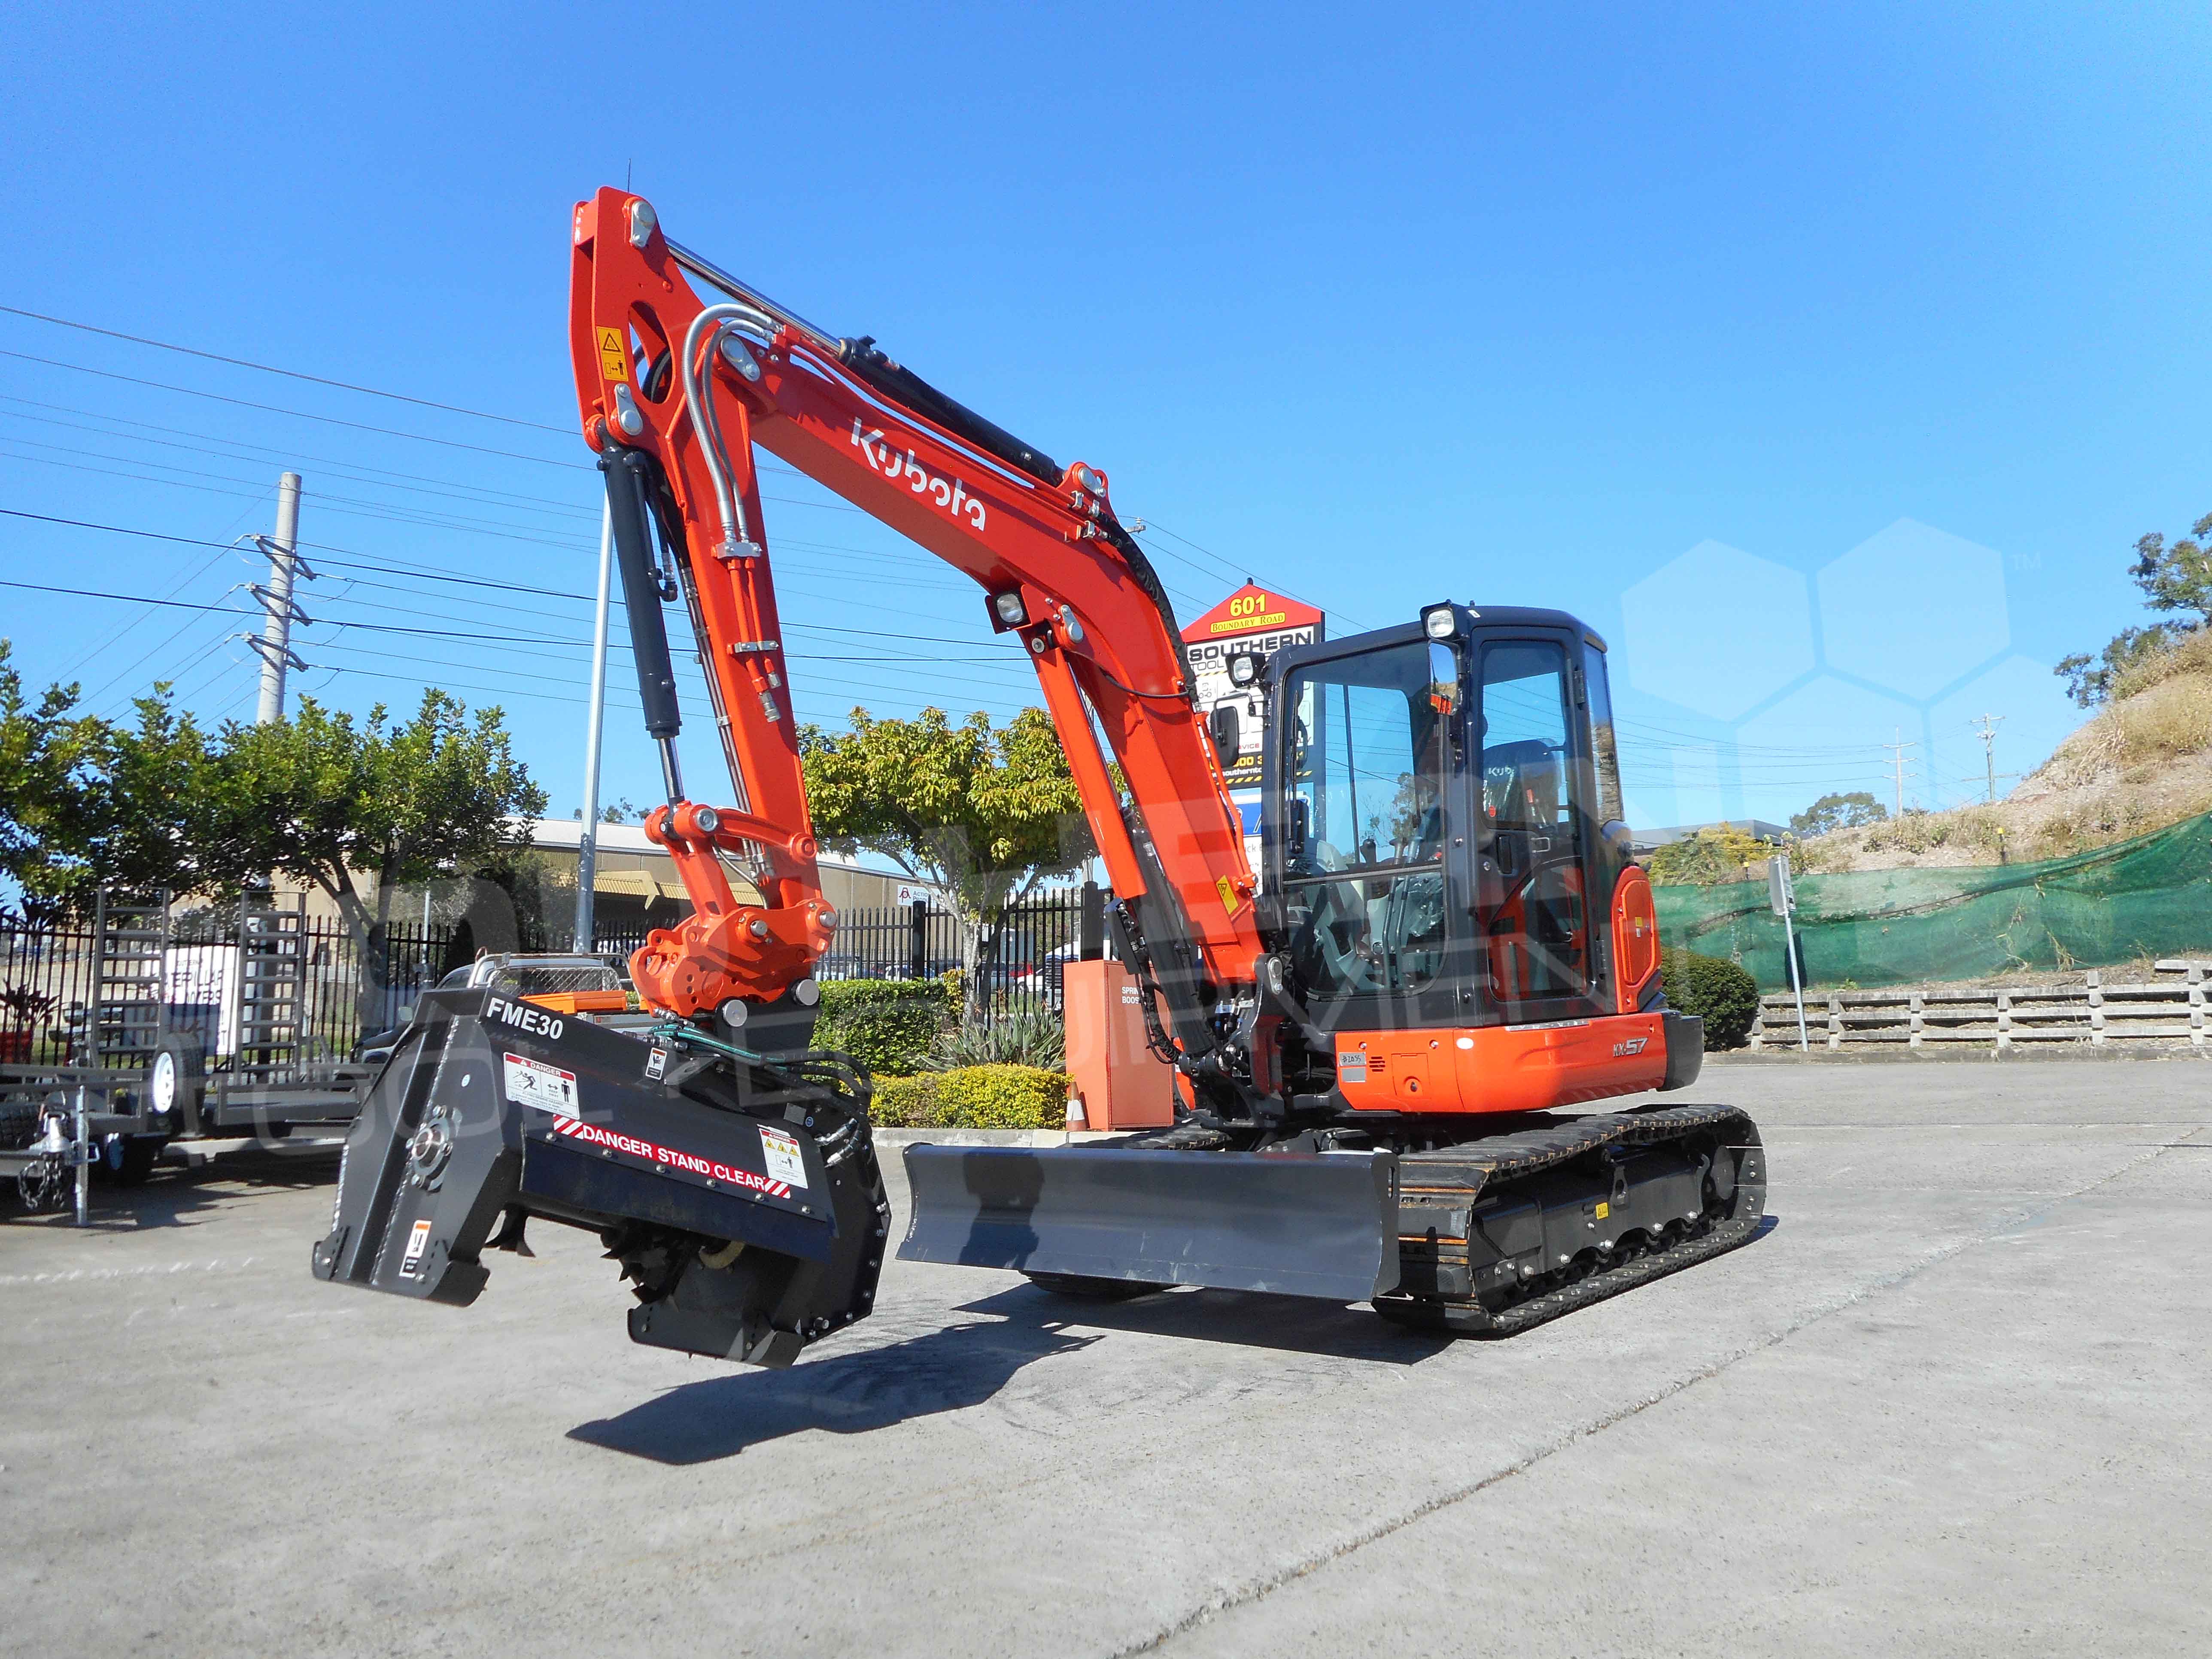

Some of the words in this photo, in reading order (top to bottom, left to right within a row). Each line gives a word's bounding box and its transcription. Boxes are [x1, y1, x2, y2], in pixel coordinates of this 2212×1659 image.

[851, 416, 986, 531] Kubota
[1230, 593, 1266, 617] 601
[1189, 631, 1312, 662] SOUTHERN
[1121, 986, 1139, 995] SPRIN
[486, 997, 563, 1040] FME30
[530, 1062, 561, 1076] DANGER
[583, 1125, 653, 1158] DANGER
[658, 1148, 711, 1174] STAND
[714, 1164, 766, 1190] CLEAR
